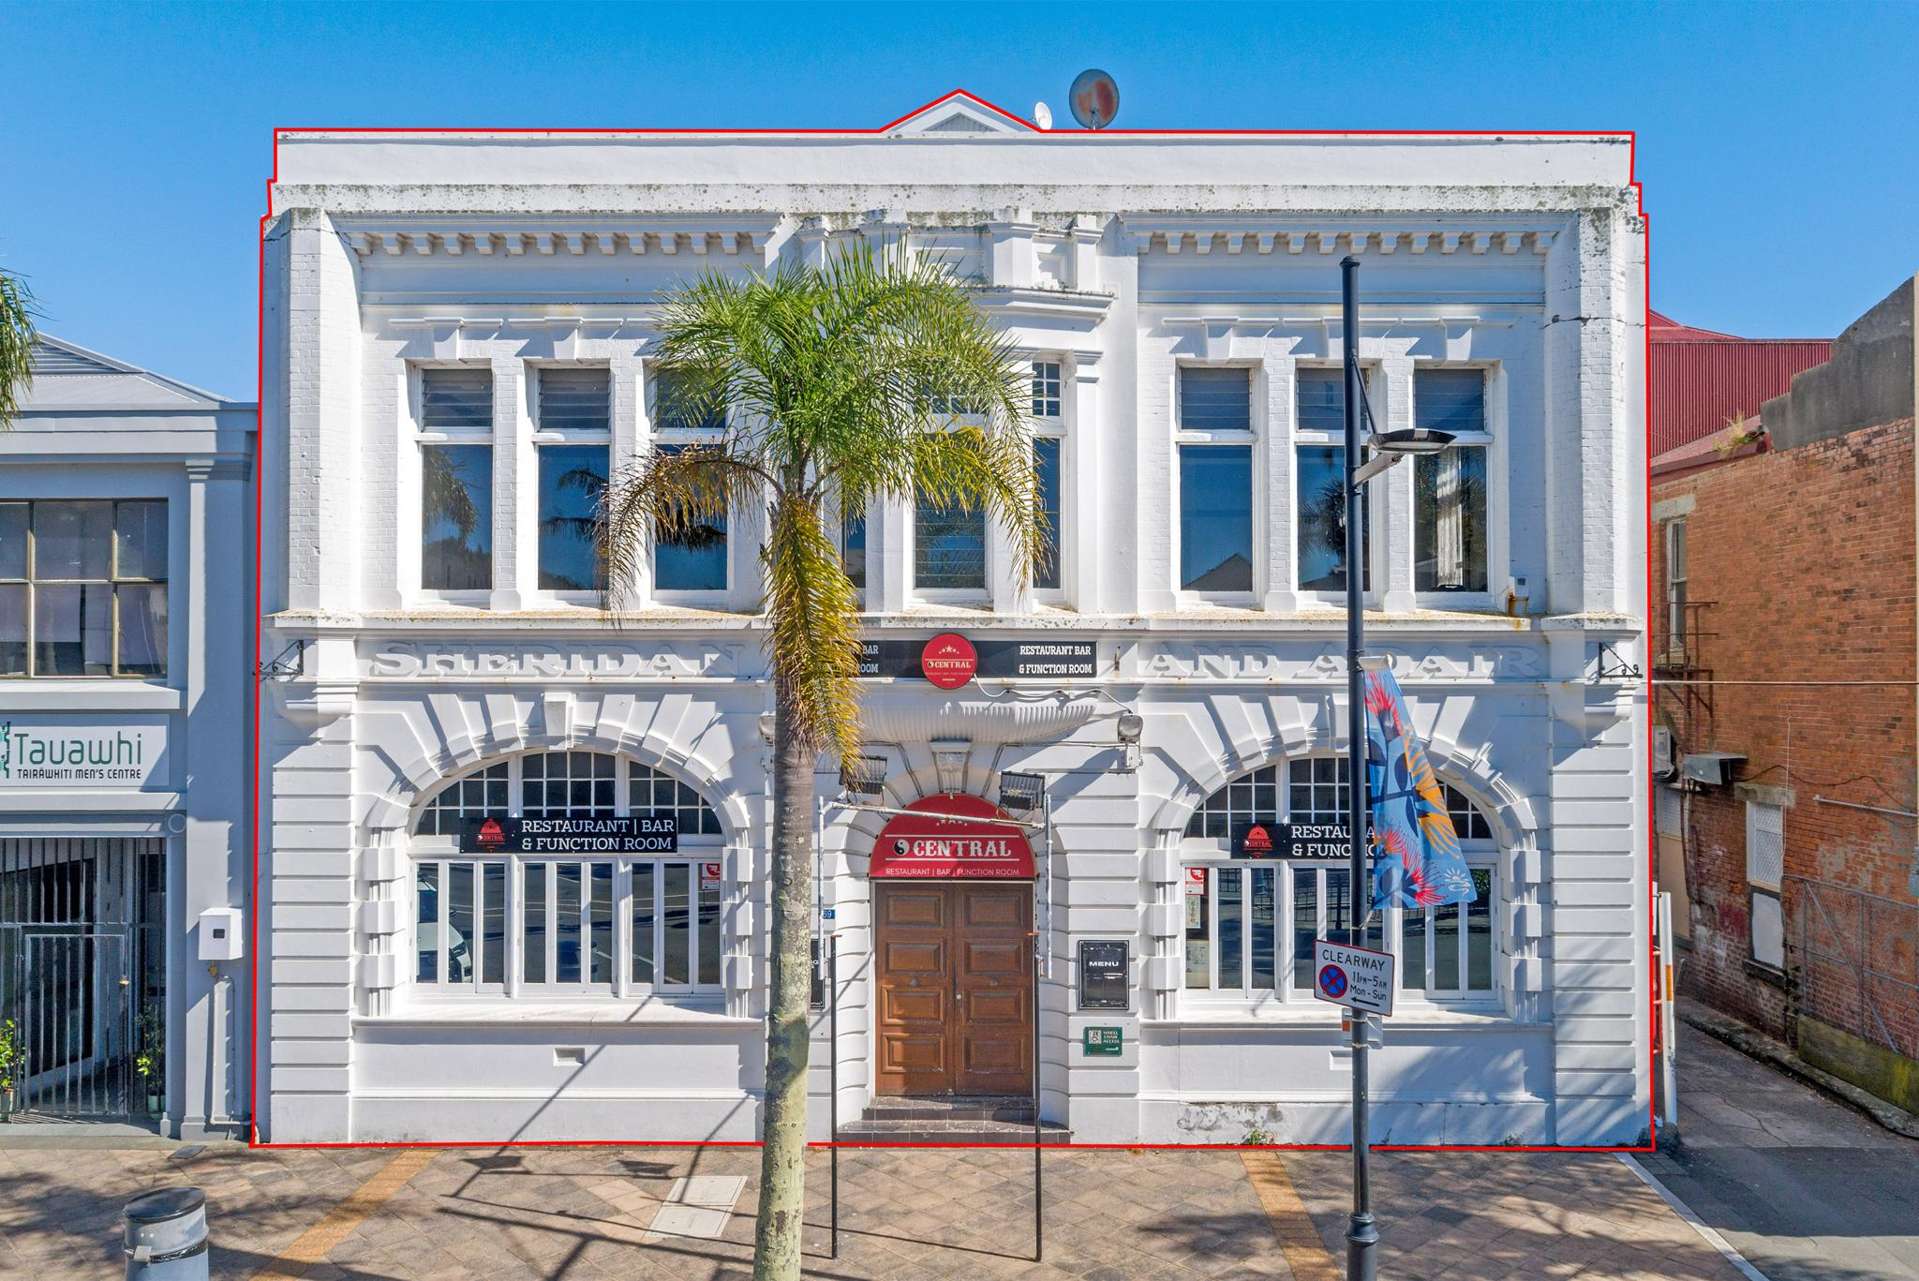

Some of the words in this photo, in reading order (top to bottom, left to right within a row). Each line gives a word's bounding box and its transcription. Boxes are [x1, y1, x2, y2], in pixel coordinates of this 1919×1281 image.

[1019, 645, 1073, 655] RESTAURANT
[1074, 645, 1092, 655] BAR
[373, 641, 746, 678] SHERIDAN
[935, 661, 971, 669] CENTRAL
[1143, 642, 1277, 678] AND
[860, 663, 879, 673] OOM
[1019, 663, 1025, 674] &
[1026, 664, 1067, 674] FUNCTION
[1068, 664, 1092, 674] ROOM
[14, 731, 142, 765] Tauawhi
[75, 768, 104, 779] MEN'S
[107, 768, 142, 779] CENTRE
[521, 820, 629, 833] RESTAURANT
[641, 819, 675, 832] BAR
[1291, 825, 1375, 839] RESTAUA
[521, 837, 532, 850] &
[536, 837, 620, 850] FUNCTION
[623, 837, 673, 850] ROOM
[913, 840, 1012, 857] CENTRAL
[1291, 843, 1303, 856] &
[1307, 843, 1375, 857] FUNCO
[885, 868, 930, 876] RESTAURANT
[936, 868, 950, 876] BAR
[956, 868, 994, 876] FUNCTION
[996, 868, 1019, 876] ROOM
[1322, 949, 1385, 971] CLEARWAY
